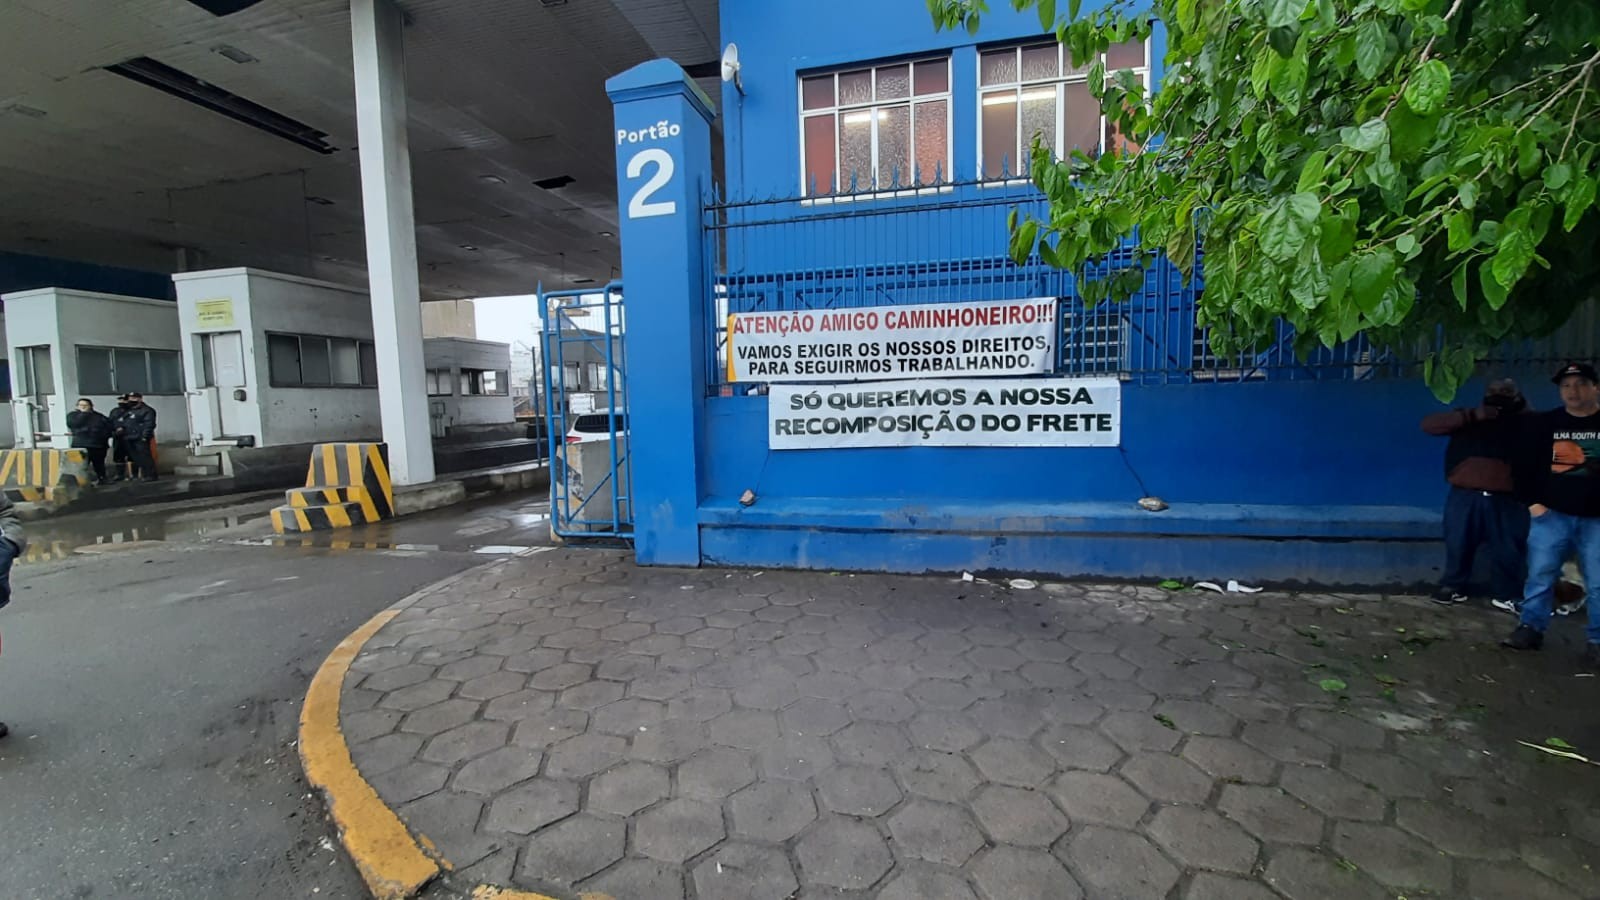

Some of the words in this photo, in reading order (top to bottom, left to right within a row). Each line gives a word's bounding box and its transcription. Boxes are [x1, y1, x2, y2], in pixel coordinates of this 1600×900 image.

[617, 120, 680, 145] Portão
[626, 148, 676, 219] 2
[733, 311, 814, 337] ATENÇÃO
[821, 311, 878, 331] AMIGO
[884, 304, 1053, 330] CAMINHONEIRO!!!
[738, 344, 792, 360] VAMOS
[798, 342, 853, 358] EXIGIR
[859, 342, 880, 357] OS
[886, 340, 956, 356] NOSSOS
[963, 336, 1051, 354] DIREITOS,
[749, 359, 789, 375] PARA
[794, 358, 891, 374] SEGUIRMOS
[897, 354, 1034, 372] TRABALHANDO.
[790, 391, 822, 410] SÓ
[828, 388, 966, 411] QUEREMOS
[974, 389, 994, 405] A
[1000, 387, 1093, 405] NOSSA
[775, 411, 975, 438] RECOMPOSIÇÃO
[981, 414, 1020, 432] DO
[1027, 413, 1112, 431] FRETE
[1571, 432, 1596, 440] SOUTH
